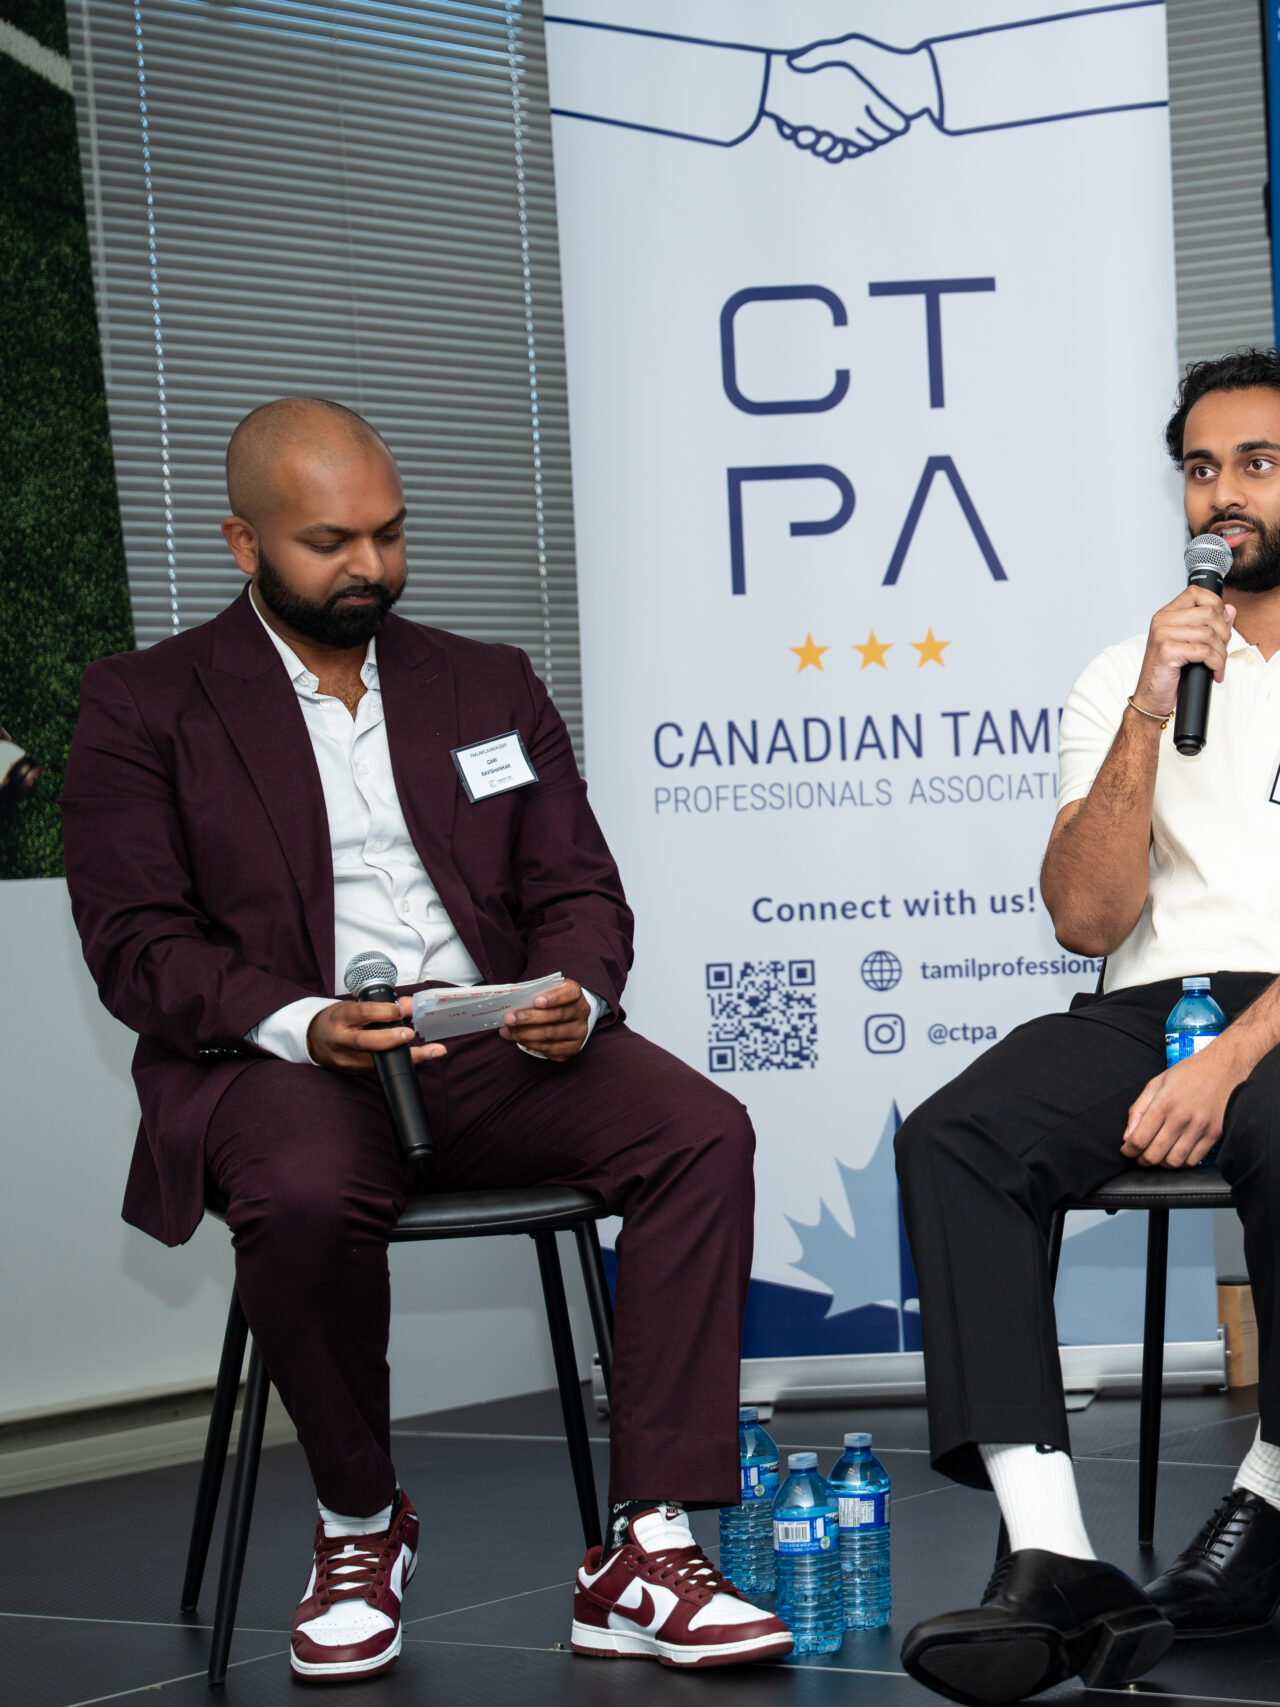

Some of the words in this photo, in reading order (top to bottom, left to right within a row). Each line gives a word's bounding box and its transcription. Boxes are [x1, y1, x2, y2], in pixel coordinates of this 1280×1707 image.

[719, 276, 996, 416] CT
[726, 455, 1009, 596] PA
[653, 713, 923, 769] CANADIAN
[941, 707, 1063, 757] TAM
[654, 778, 893, 815] PROFESSIONALS
[908, 772, 1058, 805] ASSOCIATI
[752, 895, 891, 923] Connect
[903, 889, 976, 918] with
[989, 887, 1035, 914] us!
[927, 1022, 998, 1045] @ctpa
